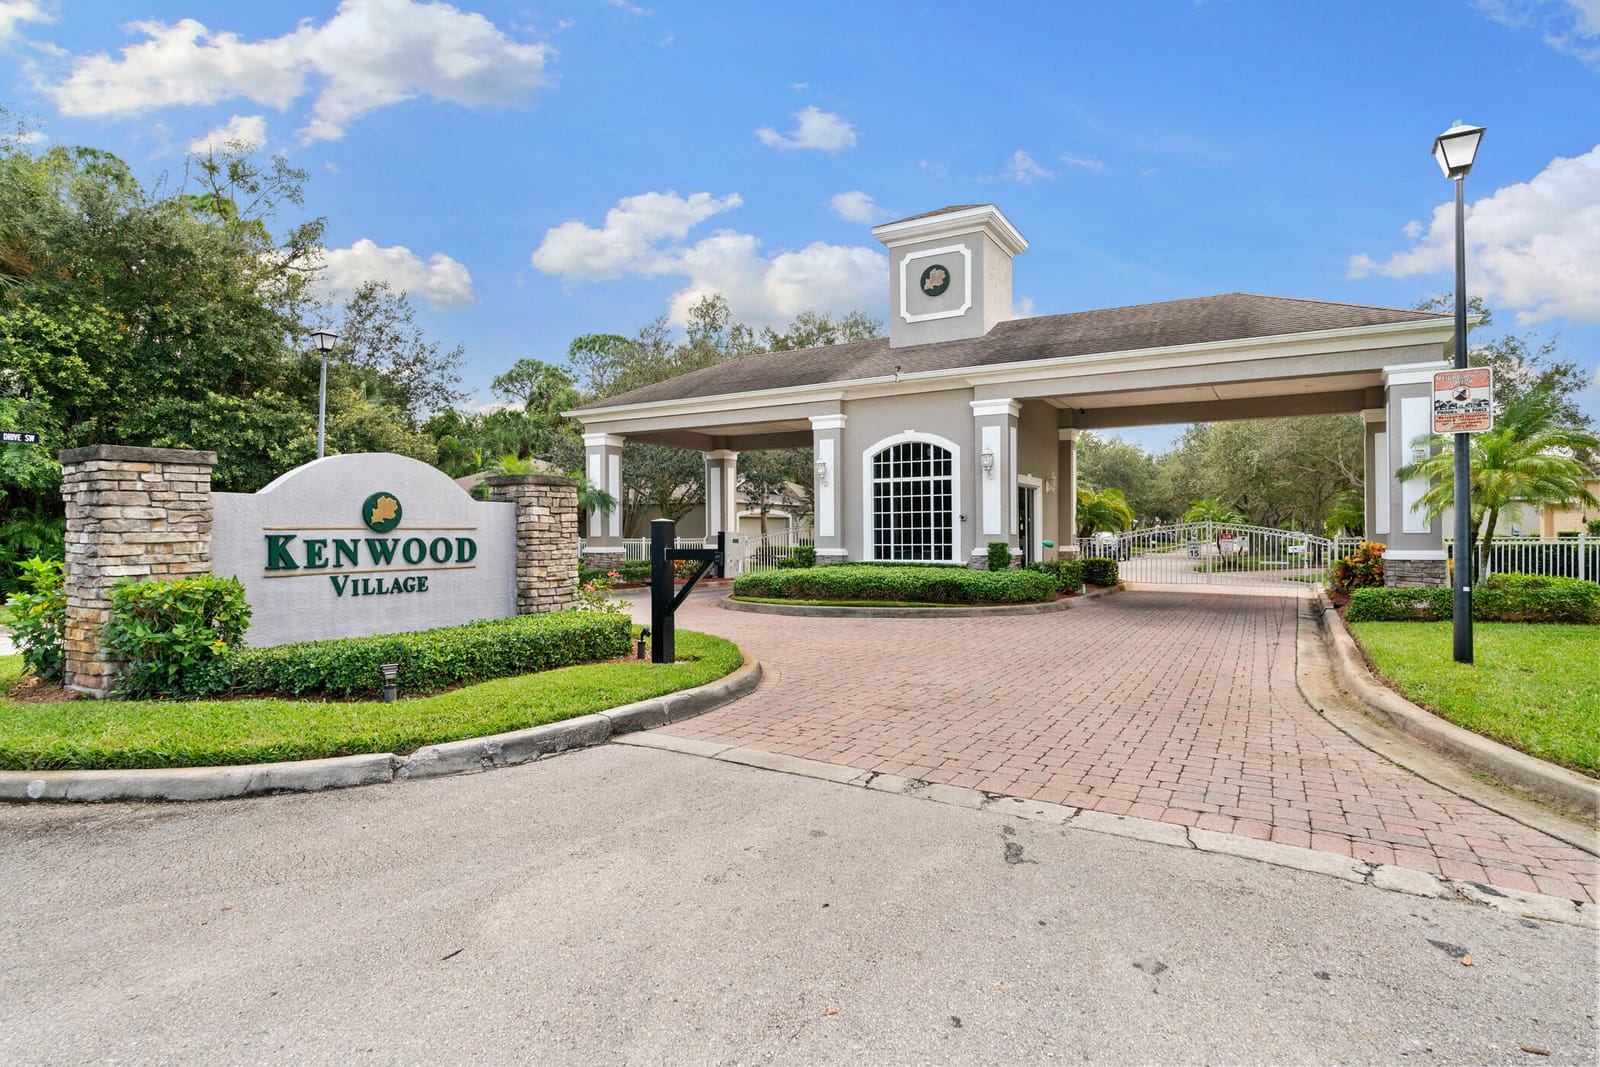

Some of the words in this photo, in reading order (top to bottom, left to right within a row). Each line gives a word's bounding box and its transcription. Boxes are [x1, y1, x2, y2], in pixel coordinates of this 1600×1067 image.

[3, 432, 22, 442] DRIVE
[24, 434, 35, 443] SW
[264, 534, 478, 571] KENWOOD
[329, 574, 429, 597] VILLAGE
